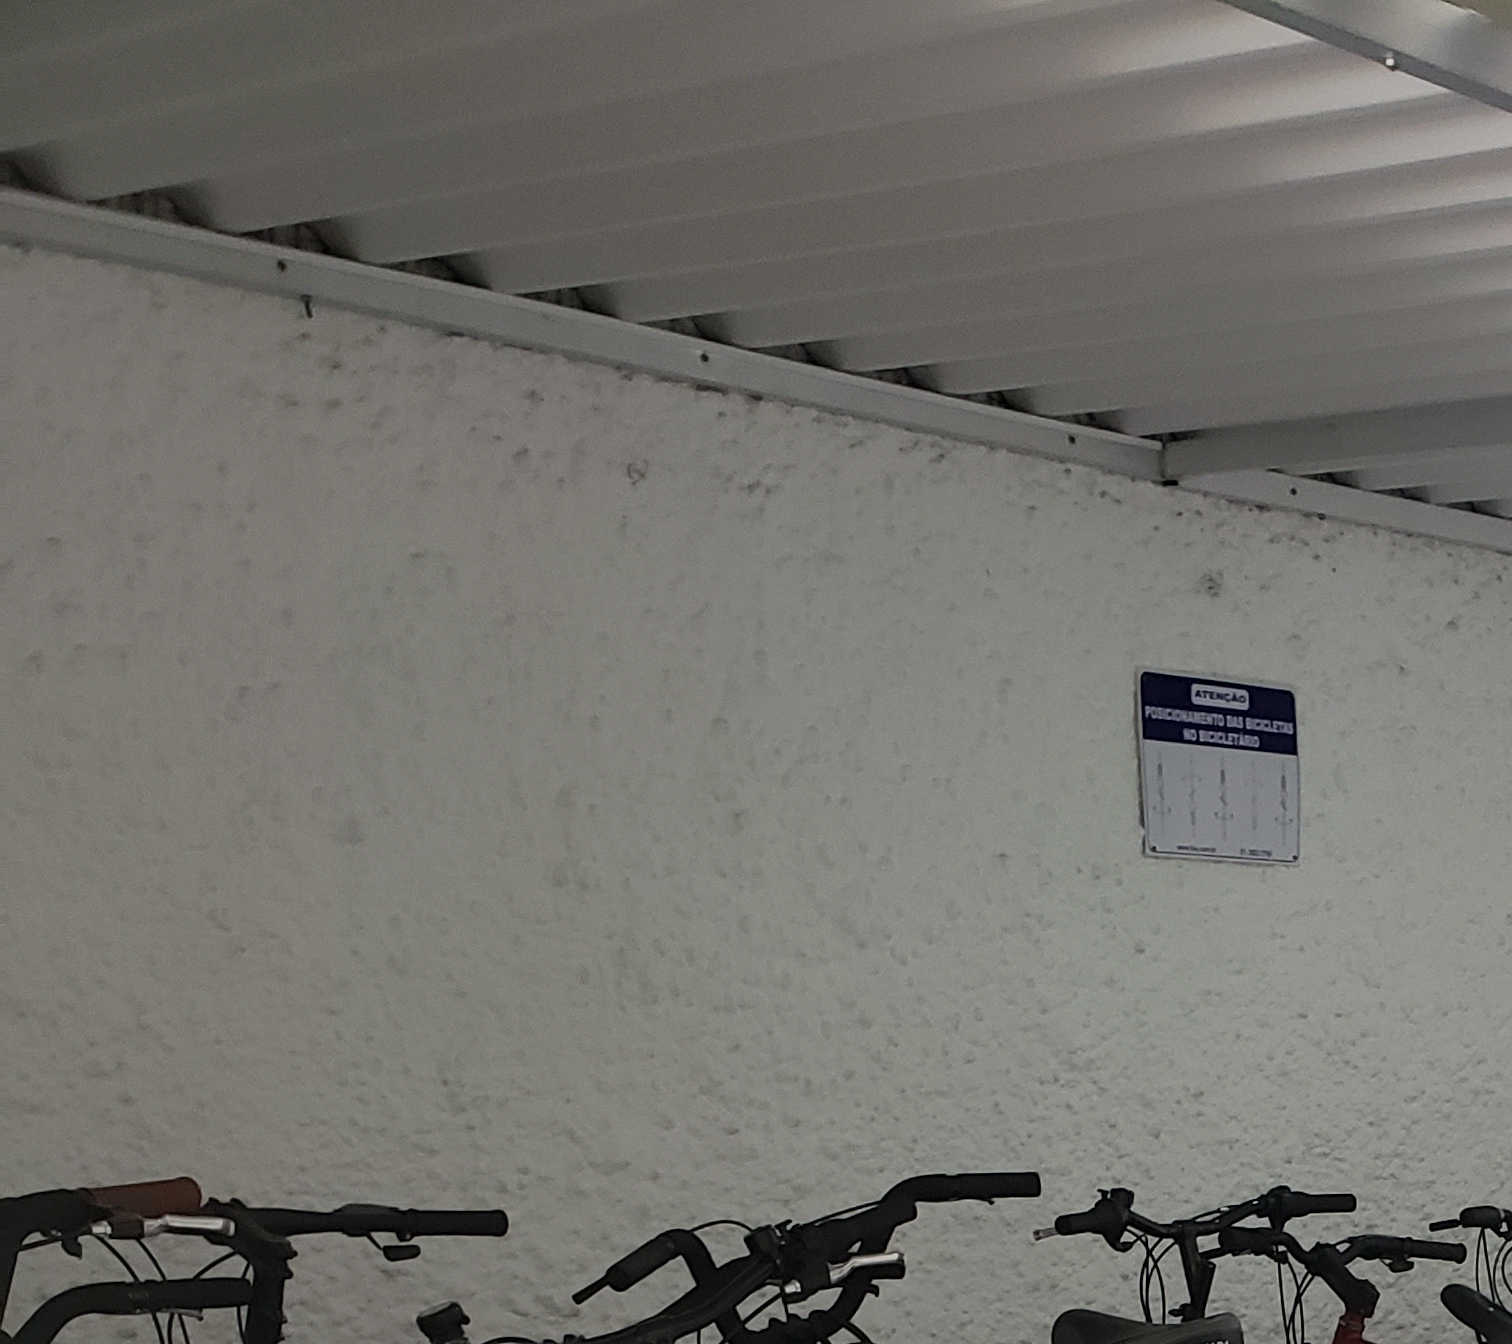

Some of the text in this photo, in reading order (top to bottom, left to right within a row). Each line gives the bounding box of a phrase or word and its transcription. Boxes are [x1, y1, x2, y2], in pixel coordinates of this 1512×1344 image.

[1194, 689, 1246, 704] ATENÇÃO
[1144, 705, 1225, 727] POSICIONAMENTO
[1199, 729, 1260, 748] BICICLETÁRIO
